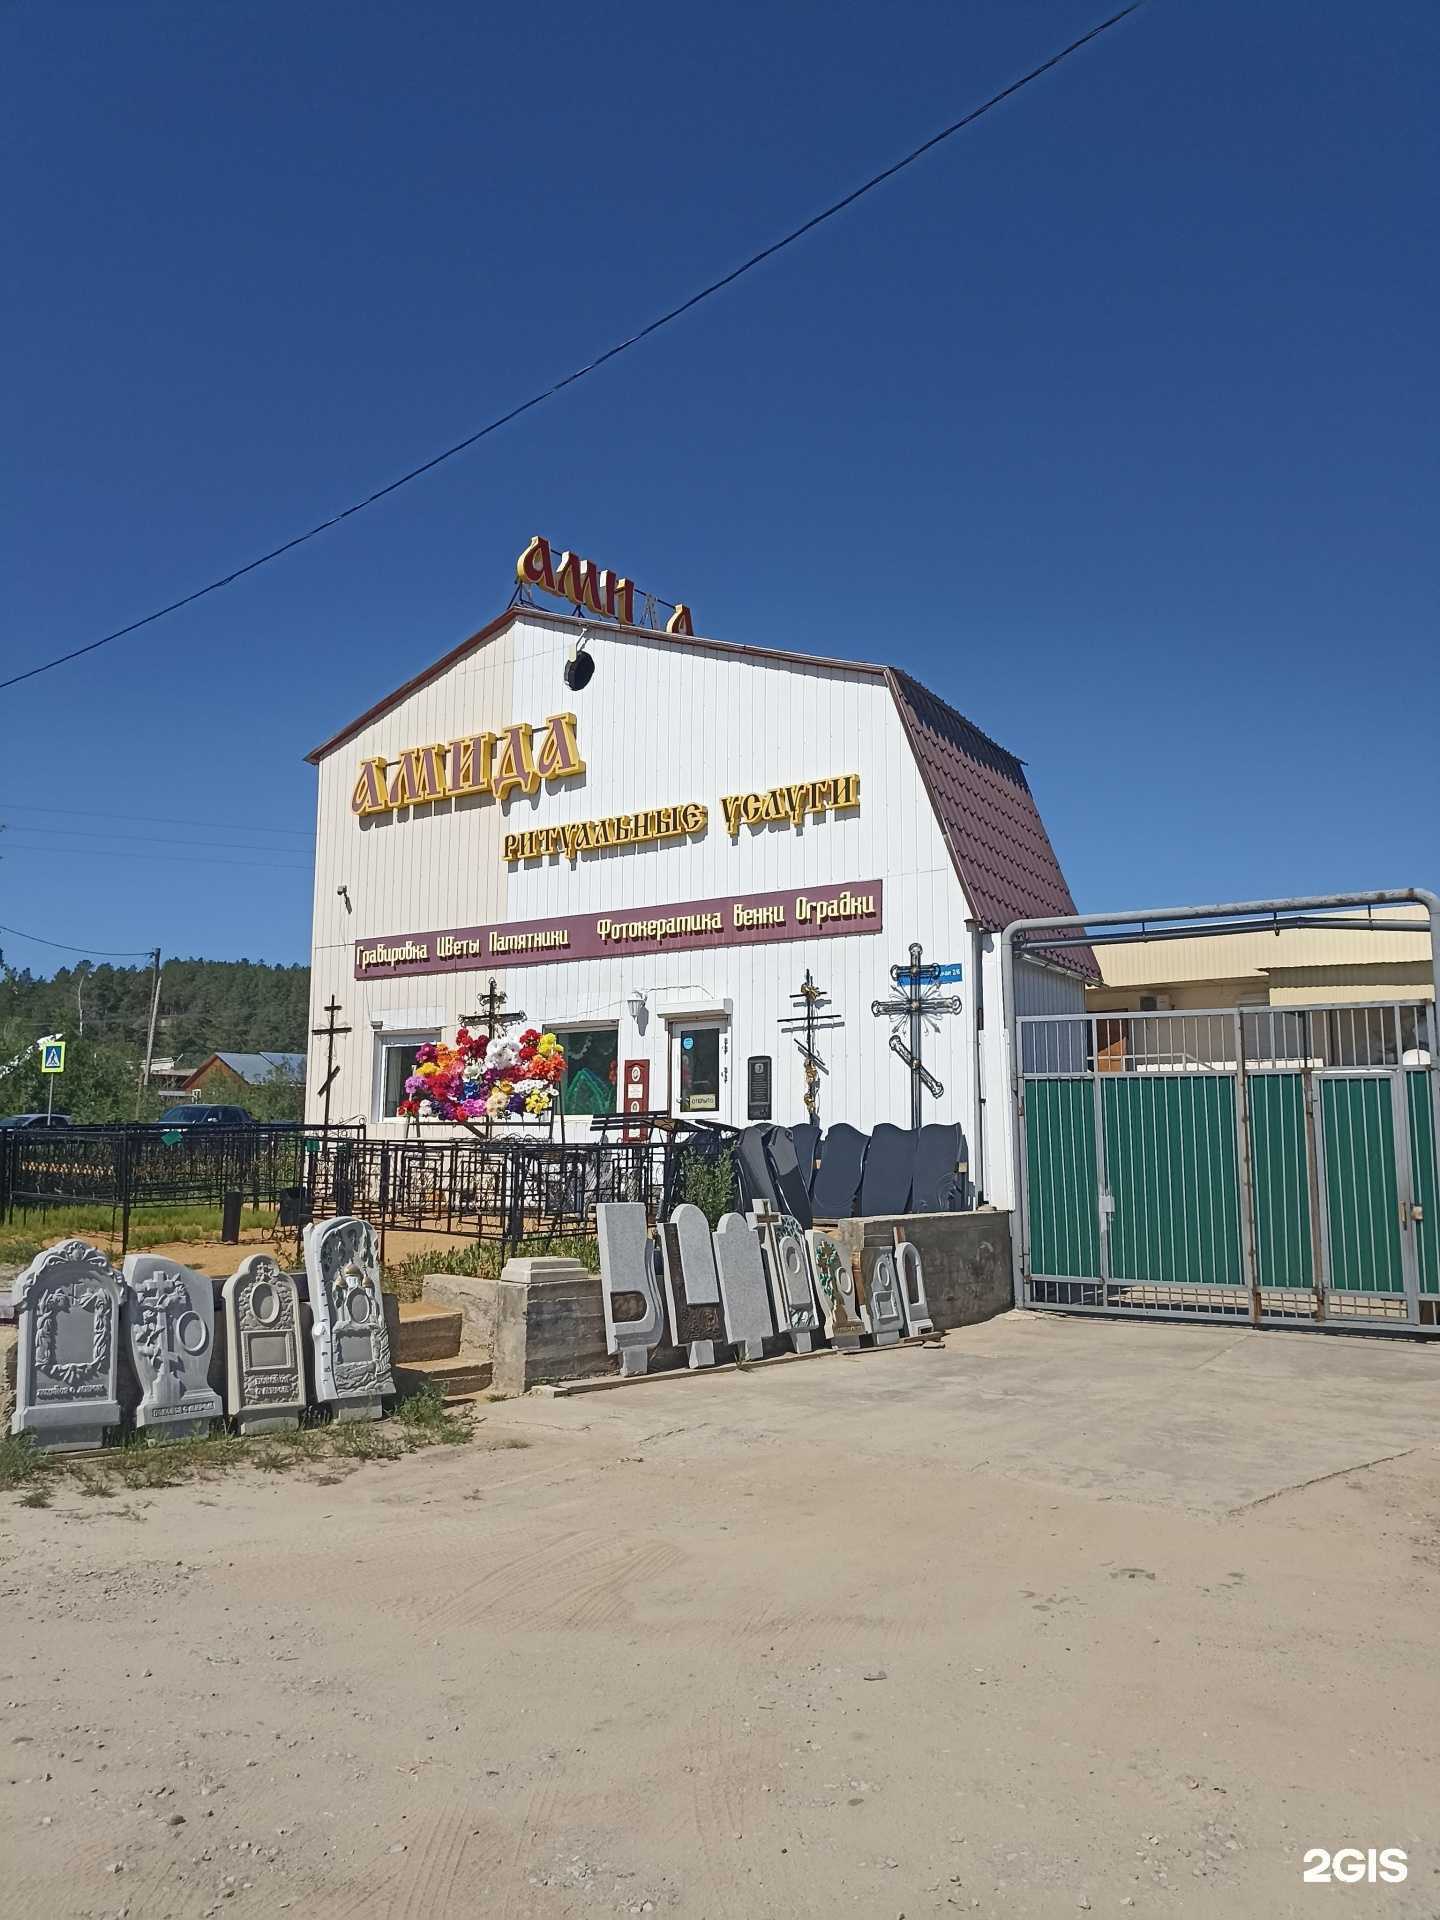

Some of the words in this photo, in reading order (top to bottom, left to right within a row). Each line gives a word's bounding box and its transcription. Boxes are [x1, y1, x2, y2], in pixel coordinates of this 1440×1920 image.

[352, 712, 585, 815] АМИДА
[504, 802, 708, 860] РИТУАЛЬНЫЕ
[720, 773, 860, 835] УСЛУГИ
[357, 941, 428, 969] Гравировка
[437, 936, 480, 958] Цветы
[489, 929, 568, 951] Памятники
[597, 912, 722, 940] Фотокерамика
[734, 903, 784, 926] Венки
[796, 891, 875, 925] Оградки
